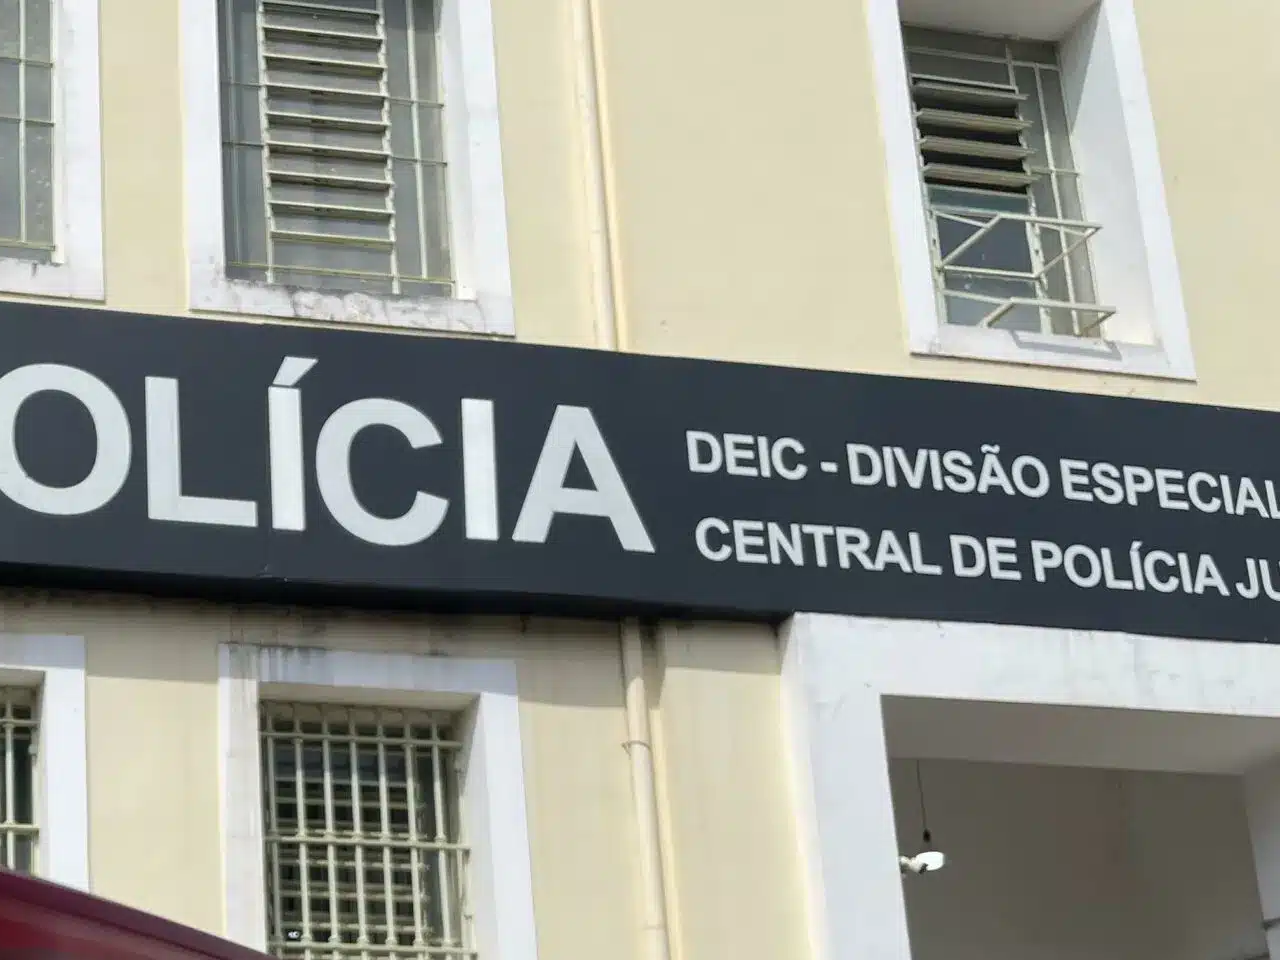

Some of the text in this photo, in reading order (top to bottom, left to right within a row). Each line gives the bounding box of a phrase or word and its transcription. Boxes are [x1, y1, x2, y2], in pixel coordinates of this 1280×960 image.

[686, 430, 808, 480] DEIC
[820, 461, 838, 473] -
[846, 443, 1050, 498] DIVISÃO
[695, 517, 943, 576] CENTRAL
[949, 534, 1022, 581] DE
[1030, 539, 1231, 597] POLÍCIA
